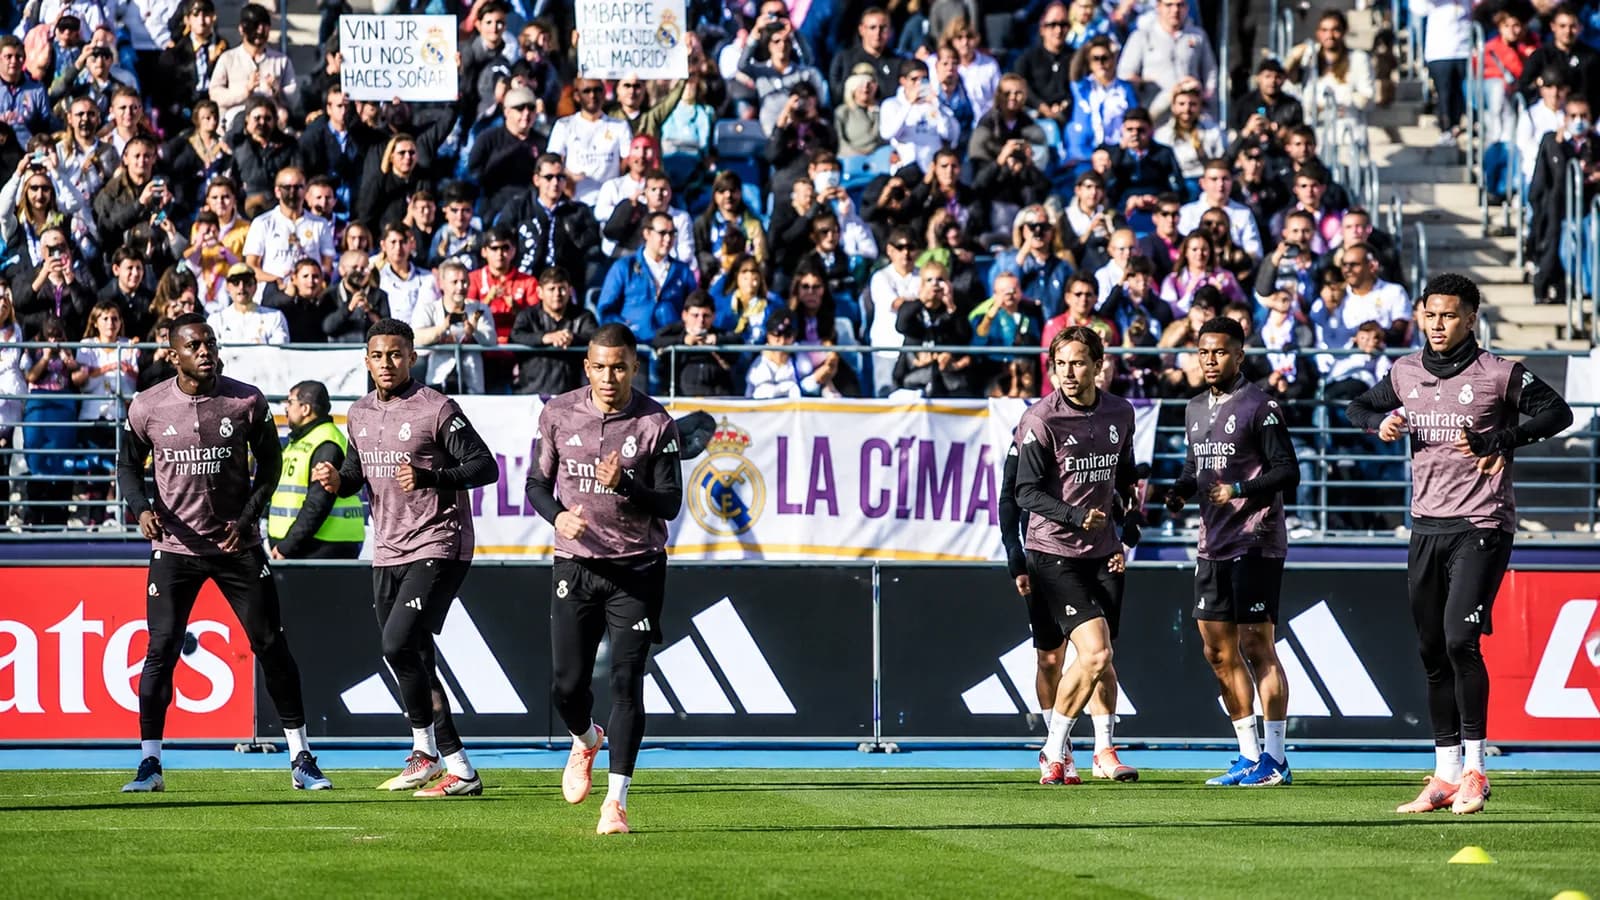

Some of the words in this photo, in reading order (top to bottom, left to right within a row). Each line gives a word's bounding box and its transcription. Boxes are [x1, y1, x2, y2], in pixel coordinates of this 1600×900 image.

[345, 19, 385, 40] VINI
[395, 20, 419, 40] JR
[348, 45, 372, 64] TU
[380, 46, 414, 65] NOS
[584, 49, 606, 68] AL
[344, 68, 392, 89] HACES
[397, 65, 448, 89] SOÑAR
[1408, 410, 1474, 428] Emirates
[1430, 428, 1462, 442] BETTER
[162, 444, 233, 462] Emirates
[175, 463, 190, 476] FLY
[191, 461, 221, 476] BETTER
[777, 435, 840, 517] LA
